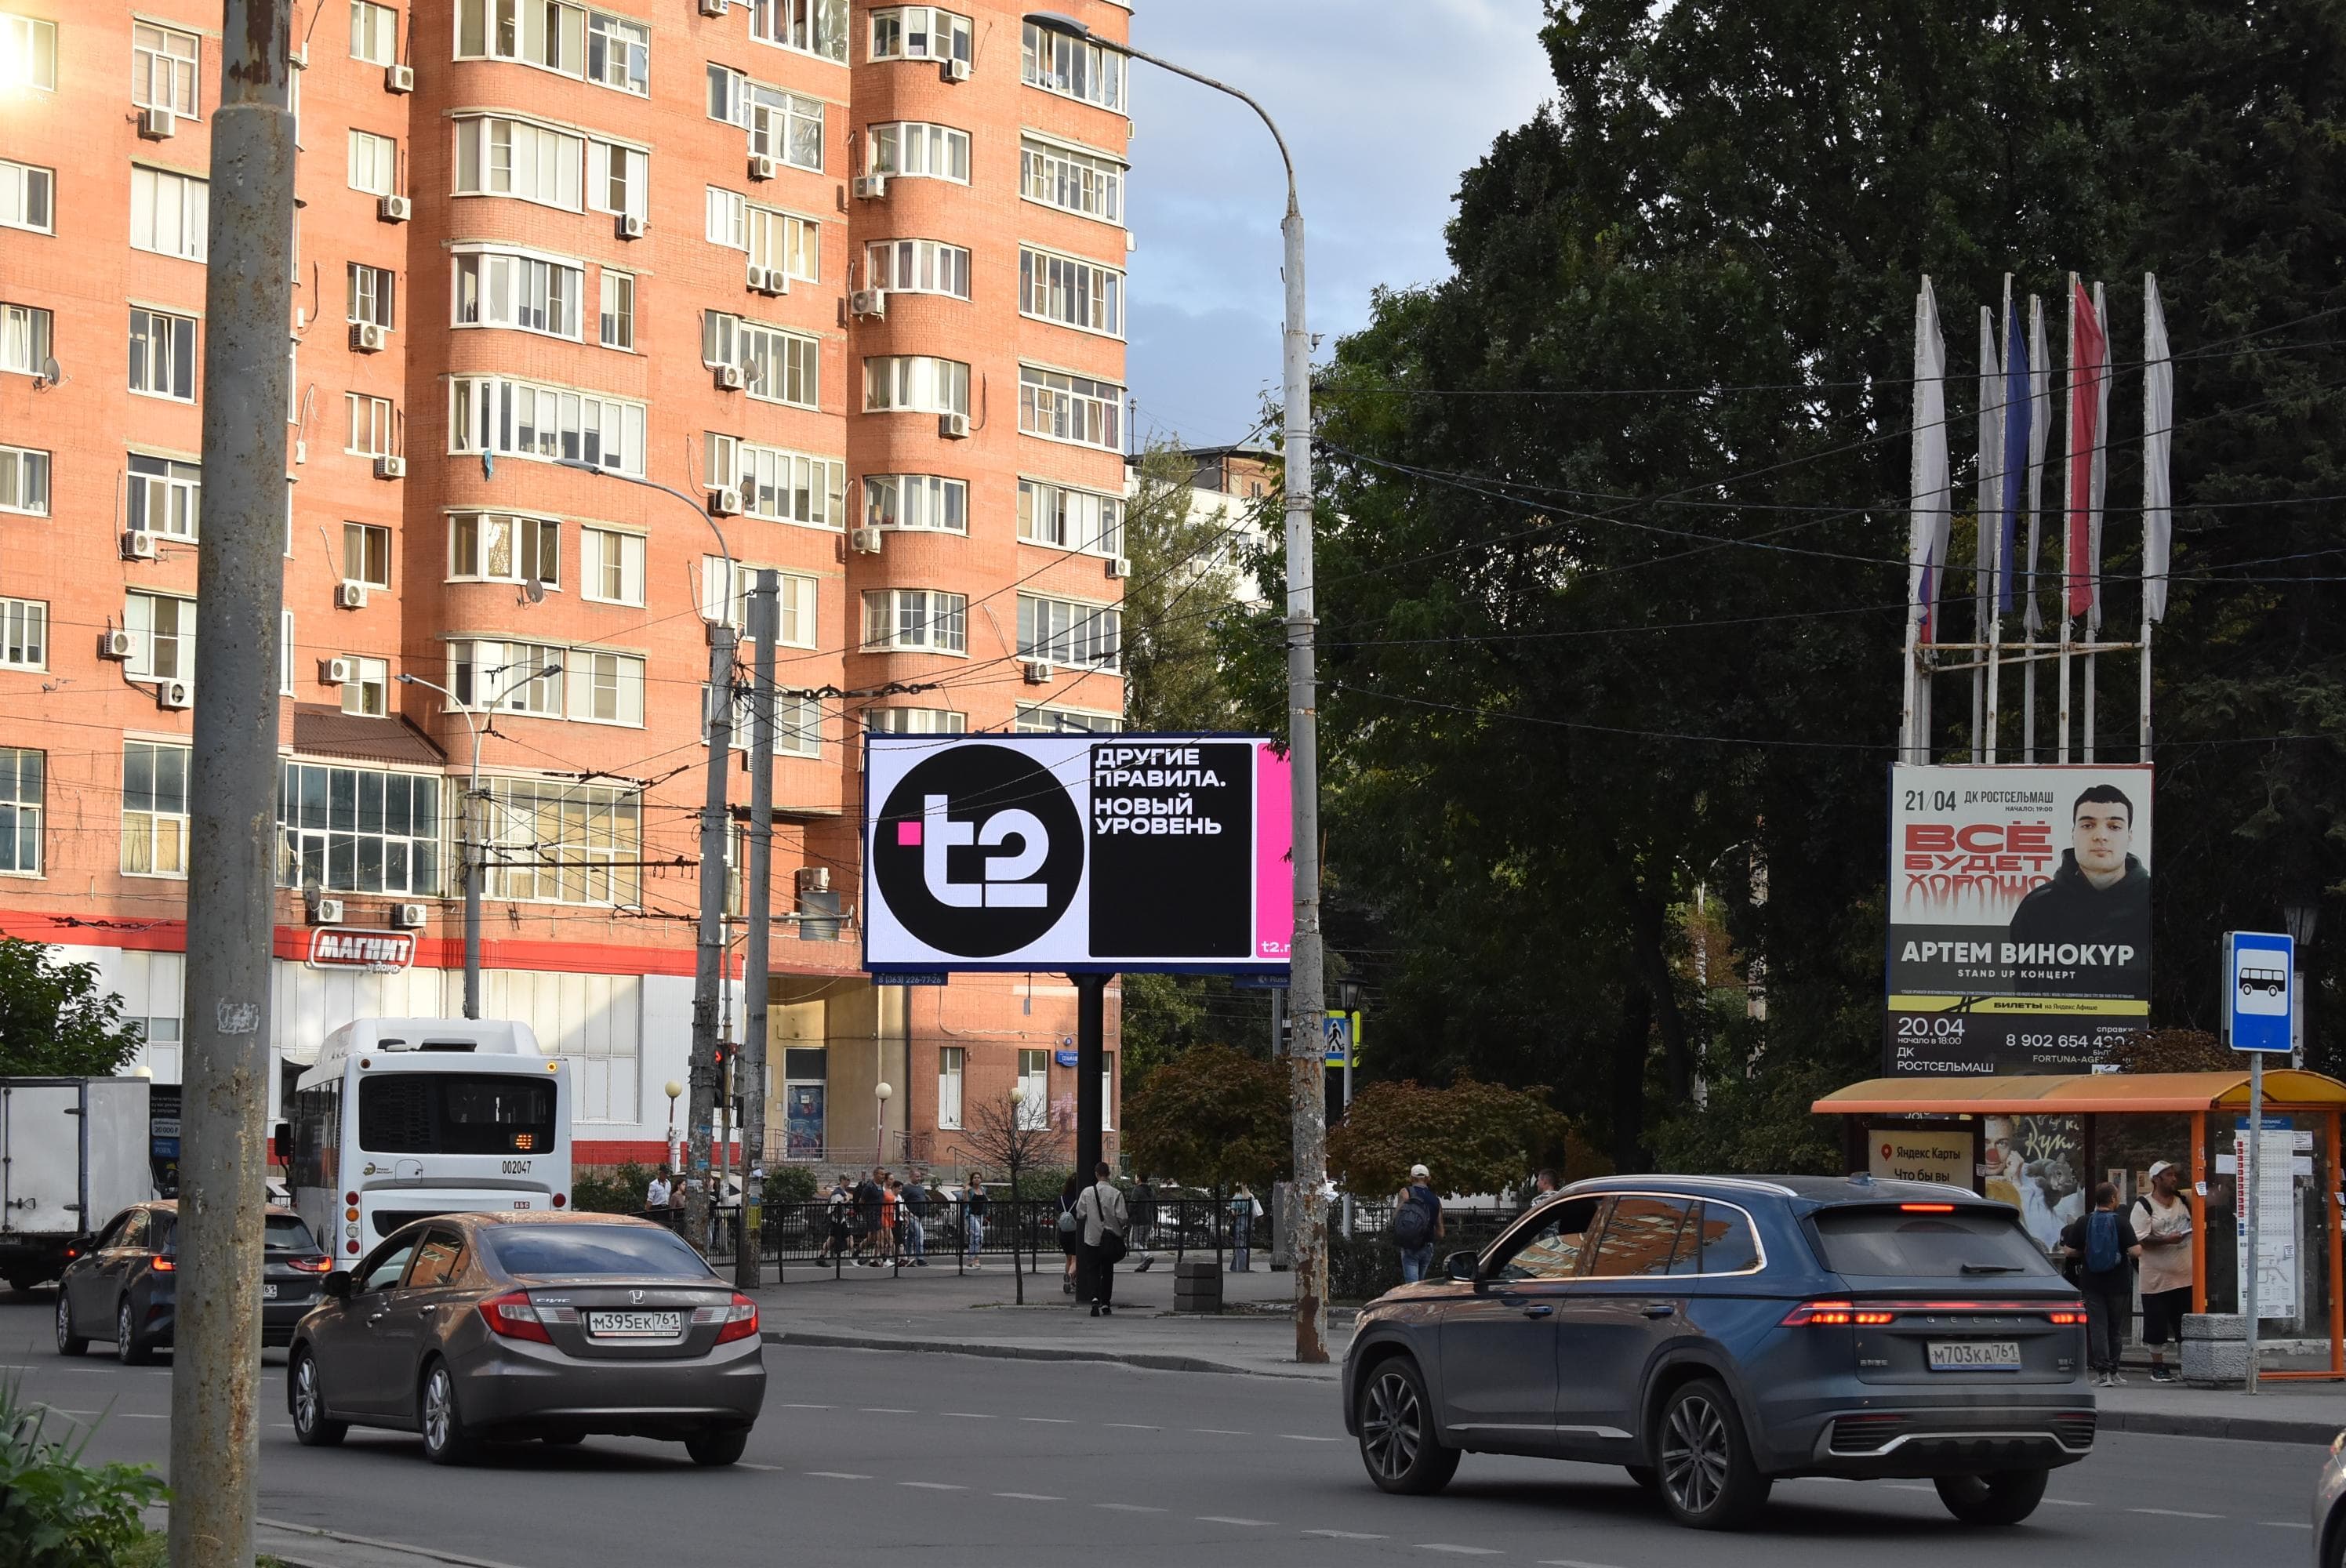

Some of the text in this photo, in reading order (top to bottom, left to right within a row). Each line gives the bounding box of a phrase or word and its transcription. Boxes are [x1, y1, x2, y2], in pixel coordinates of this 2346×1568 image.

[1095, 748, 1200, 768] ДРУГИЕ
[1095, 770, 1226, 787] ПРАВИЛА.
[1095, 793, 1193, 815] НОВЫЙ
[1905, 790, 2054, 811] 21/04 ДК РОСТСЕЛЬМАШ
[1095, 818, 1222, 835] УРОВЕНЬ
[1905, 820, 2053, 854] ВСЁ
[924, 794, 1049, 908] t2
[1905, 854, 2053, 874] БУДЕТ
[317, 935, 411, 962] МАГНИТ
[1261, 941, 1291, 953] t2.r
[1901, 941, 2135, 966] АРТЕМ ВИНОКУР
[375, 961, 401, 975] дома
[1957, 969, 2076, 980] STAND UP КОНЦЕРТ
[1898, 1017, 1966, 1037] 20.04
[1937, 1036, 1962, 1045] 18:00
[2006, 1034, 2016, 1047] 8
[2021, 1034, 2053, 1047] 902
[2058, 1035, 2088, 1047] 654
[1897, 1047, 1915, 1058] ДК
[1897, 1061, 1994, 1073] РОСТСЕЛЬМАШ
[1896, 1146, 1960, 1162] Яндекс Карты
[502, 1160, 532, 1174] 002047
[1894, 1168, 1950, 1182] Что бы вы
[264, 1285, 275, 1294] 61
[594, 1314, 652, 1330] М395ЕК
[654, 1313, 677, 1325] 761
[1934, 1345, 2016, 1364] М703КА 761
